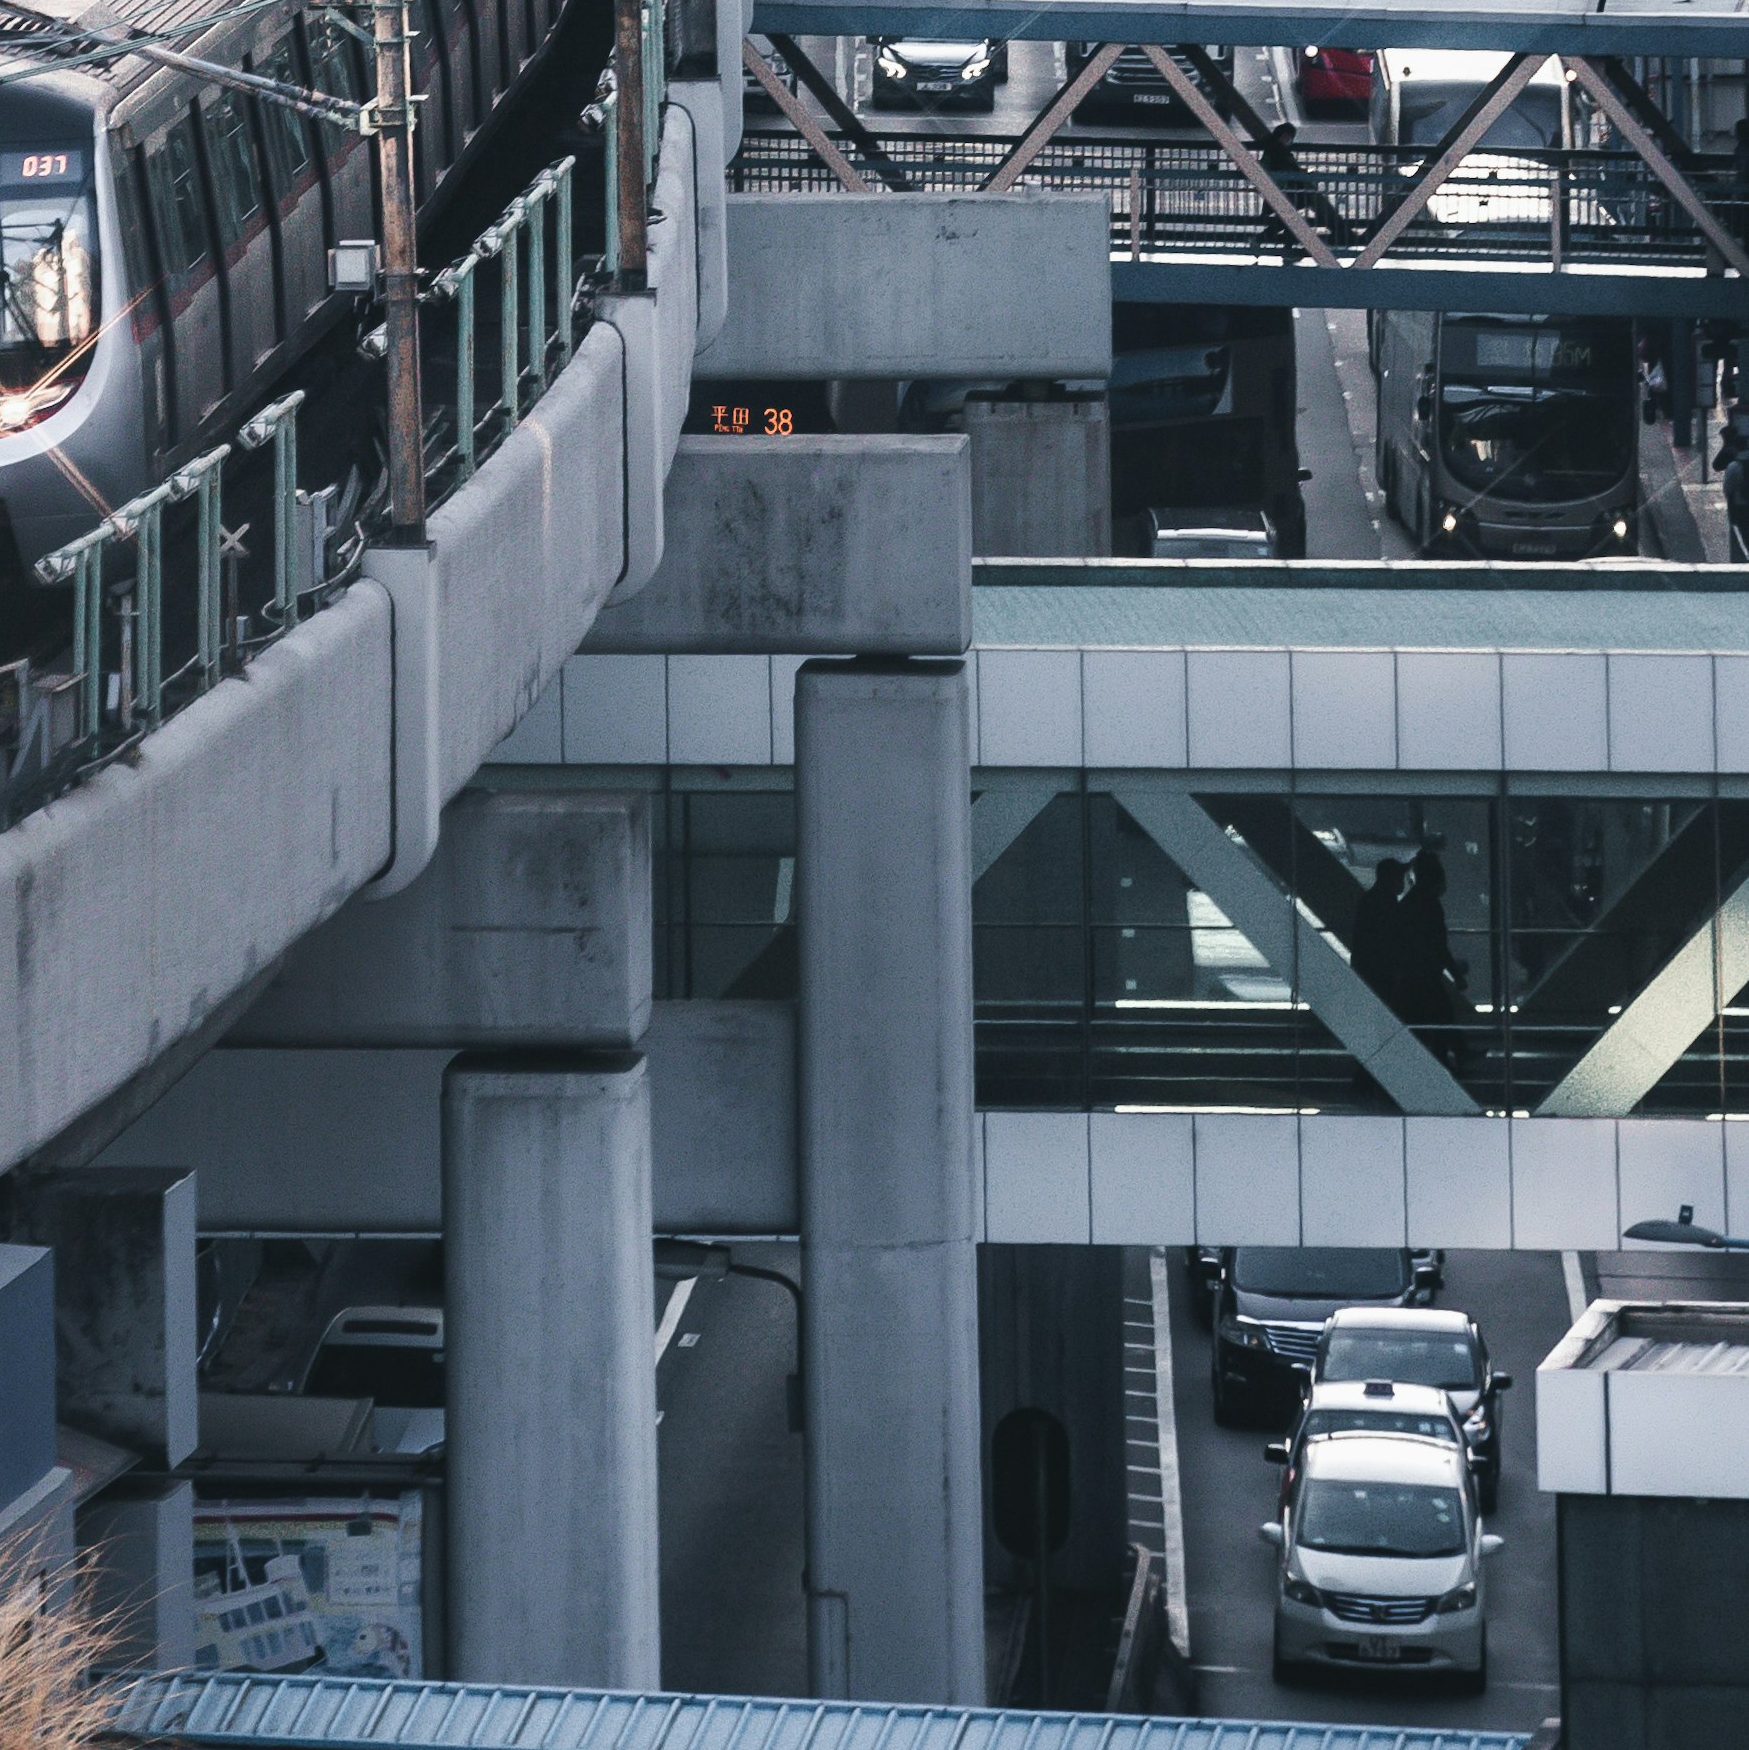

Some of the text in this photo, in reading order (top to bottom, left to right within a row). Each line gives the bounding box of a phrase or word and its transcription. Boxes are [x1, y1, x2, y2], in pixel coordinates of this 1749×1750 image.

[22, 155, 67, 177] 037
[711, 405, 793, 435] 平田 38
